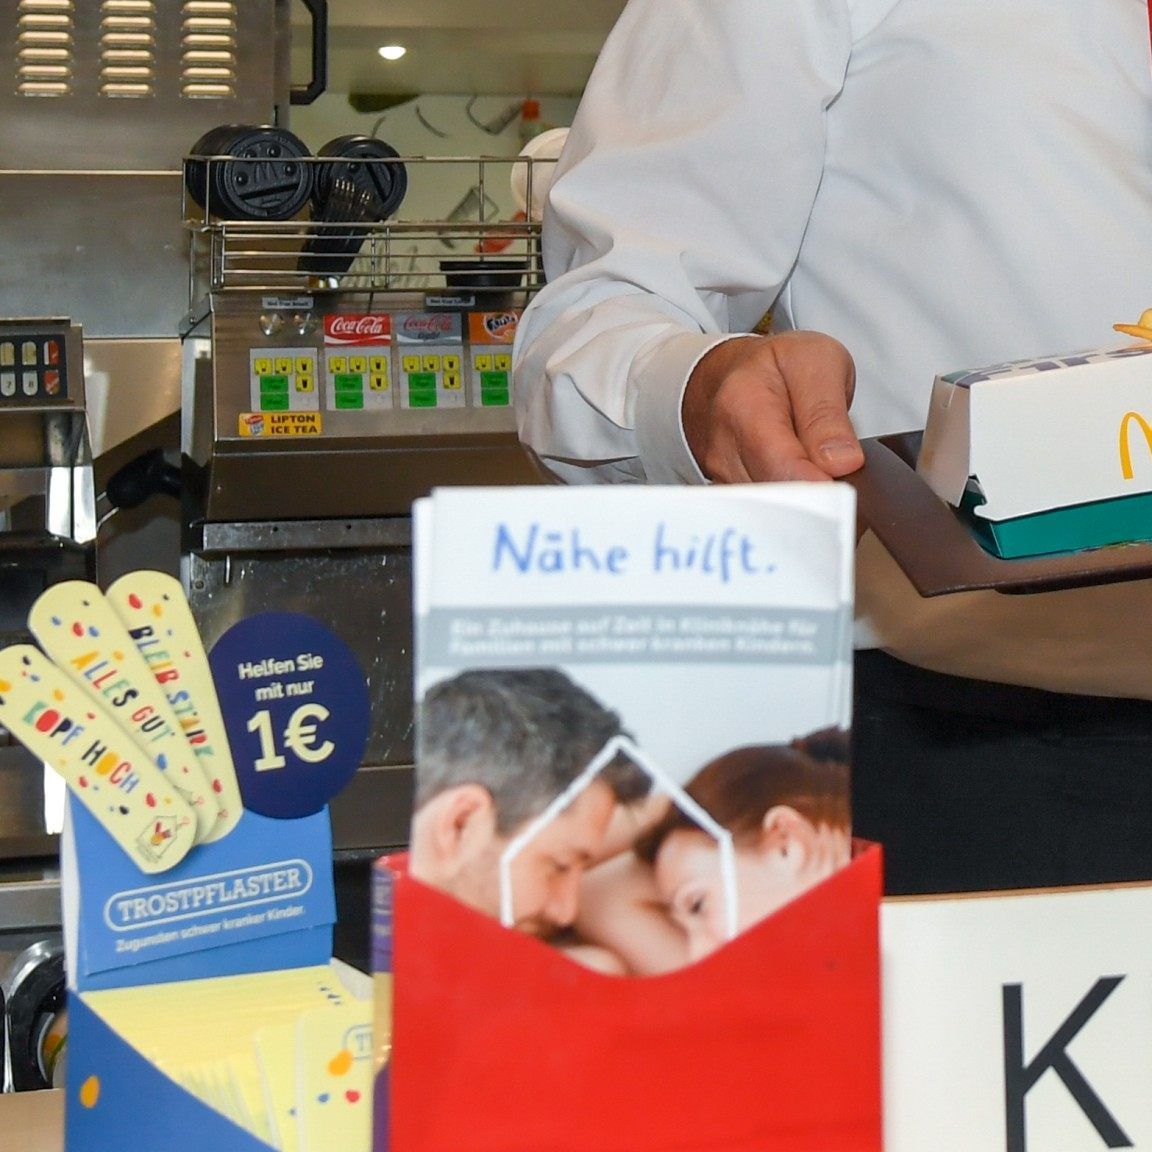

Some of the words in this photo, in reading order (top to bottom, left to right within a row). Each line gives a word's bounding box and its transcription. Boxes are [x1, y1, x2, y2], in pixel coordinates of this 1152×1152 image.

[271, 415, 315, 424] LIPTON
[271, 426, 290, 434] ICE
[294, 425, 318, 434] TEA
[491, 522, 629, 582] Nähe
[652, 521, 777, 583] hilft.
[70, 651, 139, 708] ALLES
[238, 657, 293, 680] Helfen
[296, 654, 324, 673] Sie
[255, 681, 282, 701] mit
[286, 680, 315, 697] nur
[23, 701, 85, 747] KOPF
[132, 705, 173, 743] GUT
[246, 702, 336, 773] 1€
[82, 739, 140, 794] HOCH
[117, 868, 302, 922] TROSTPFLASTER
